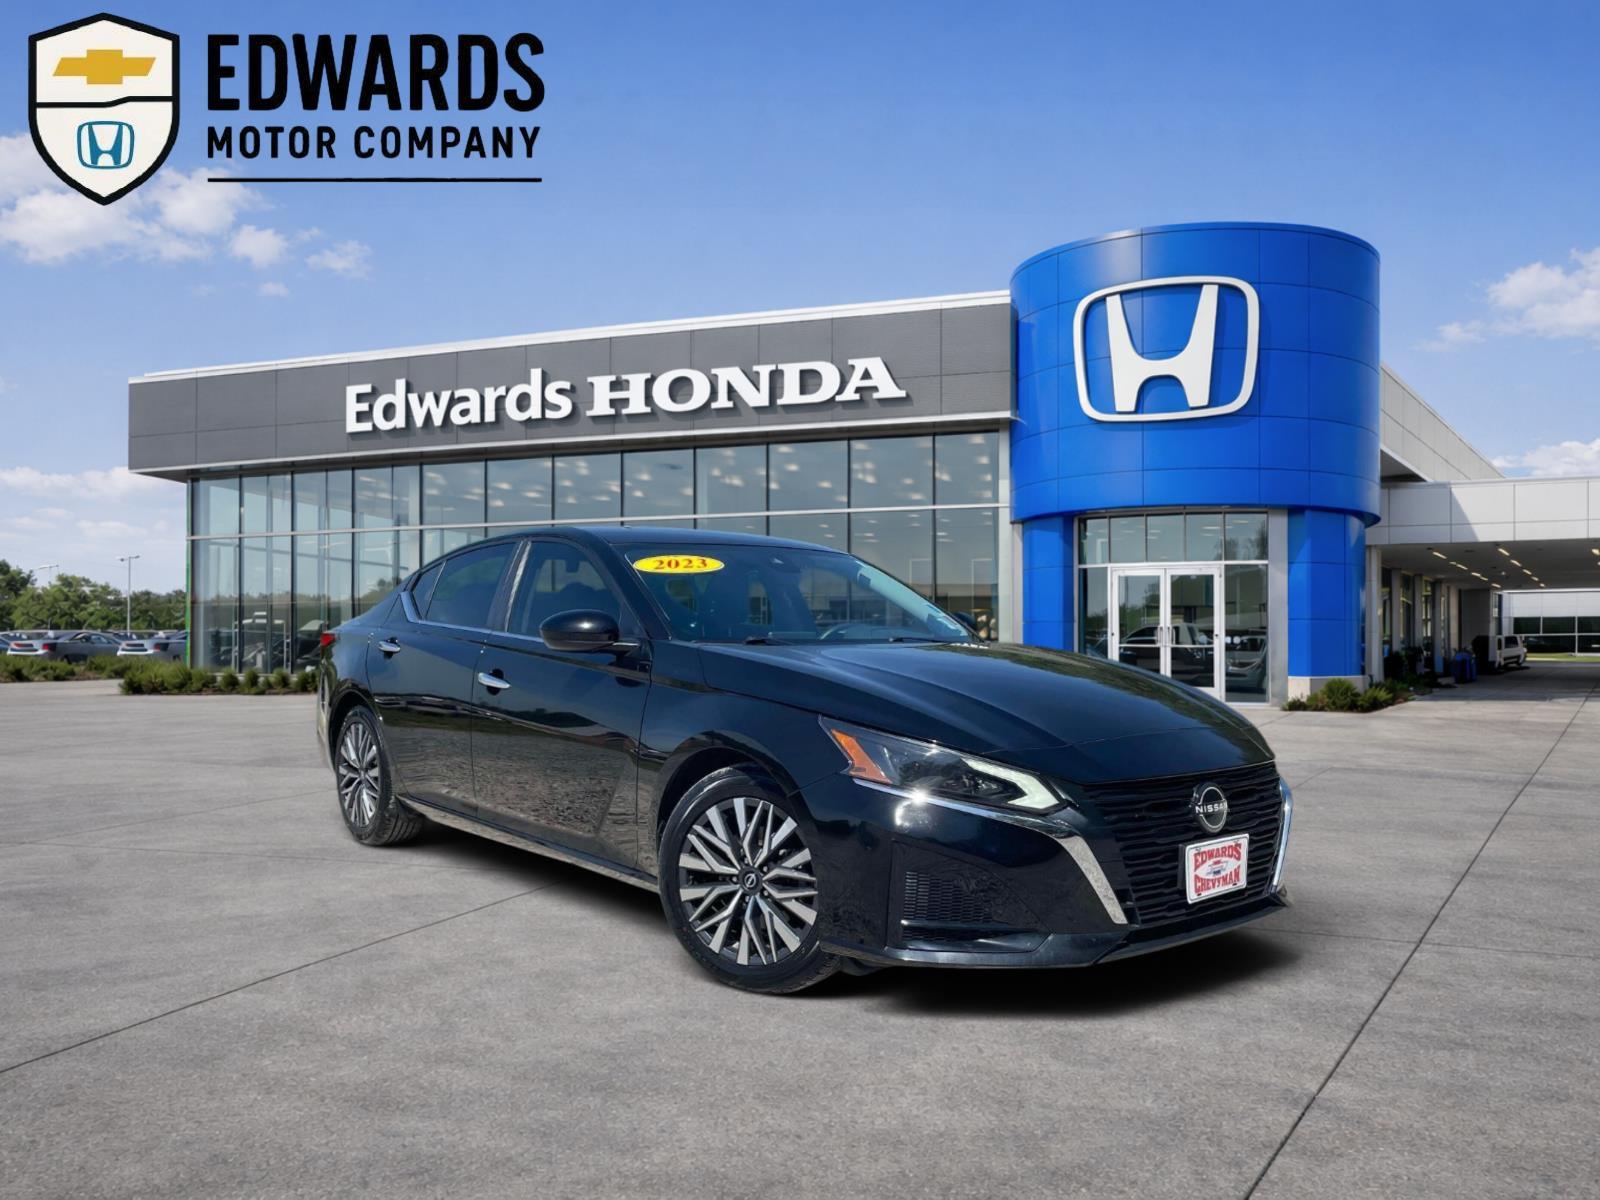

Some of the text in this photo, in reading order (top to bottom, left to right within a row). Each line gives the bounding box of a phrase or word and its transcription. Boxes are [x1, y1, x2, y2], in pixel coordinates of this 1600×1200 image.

[345, 356, 907, 434] Edwards HONDA
[653, 558, 709, 570] 2023
[1193, 843, 1242, 872] EDWARDS
